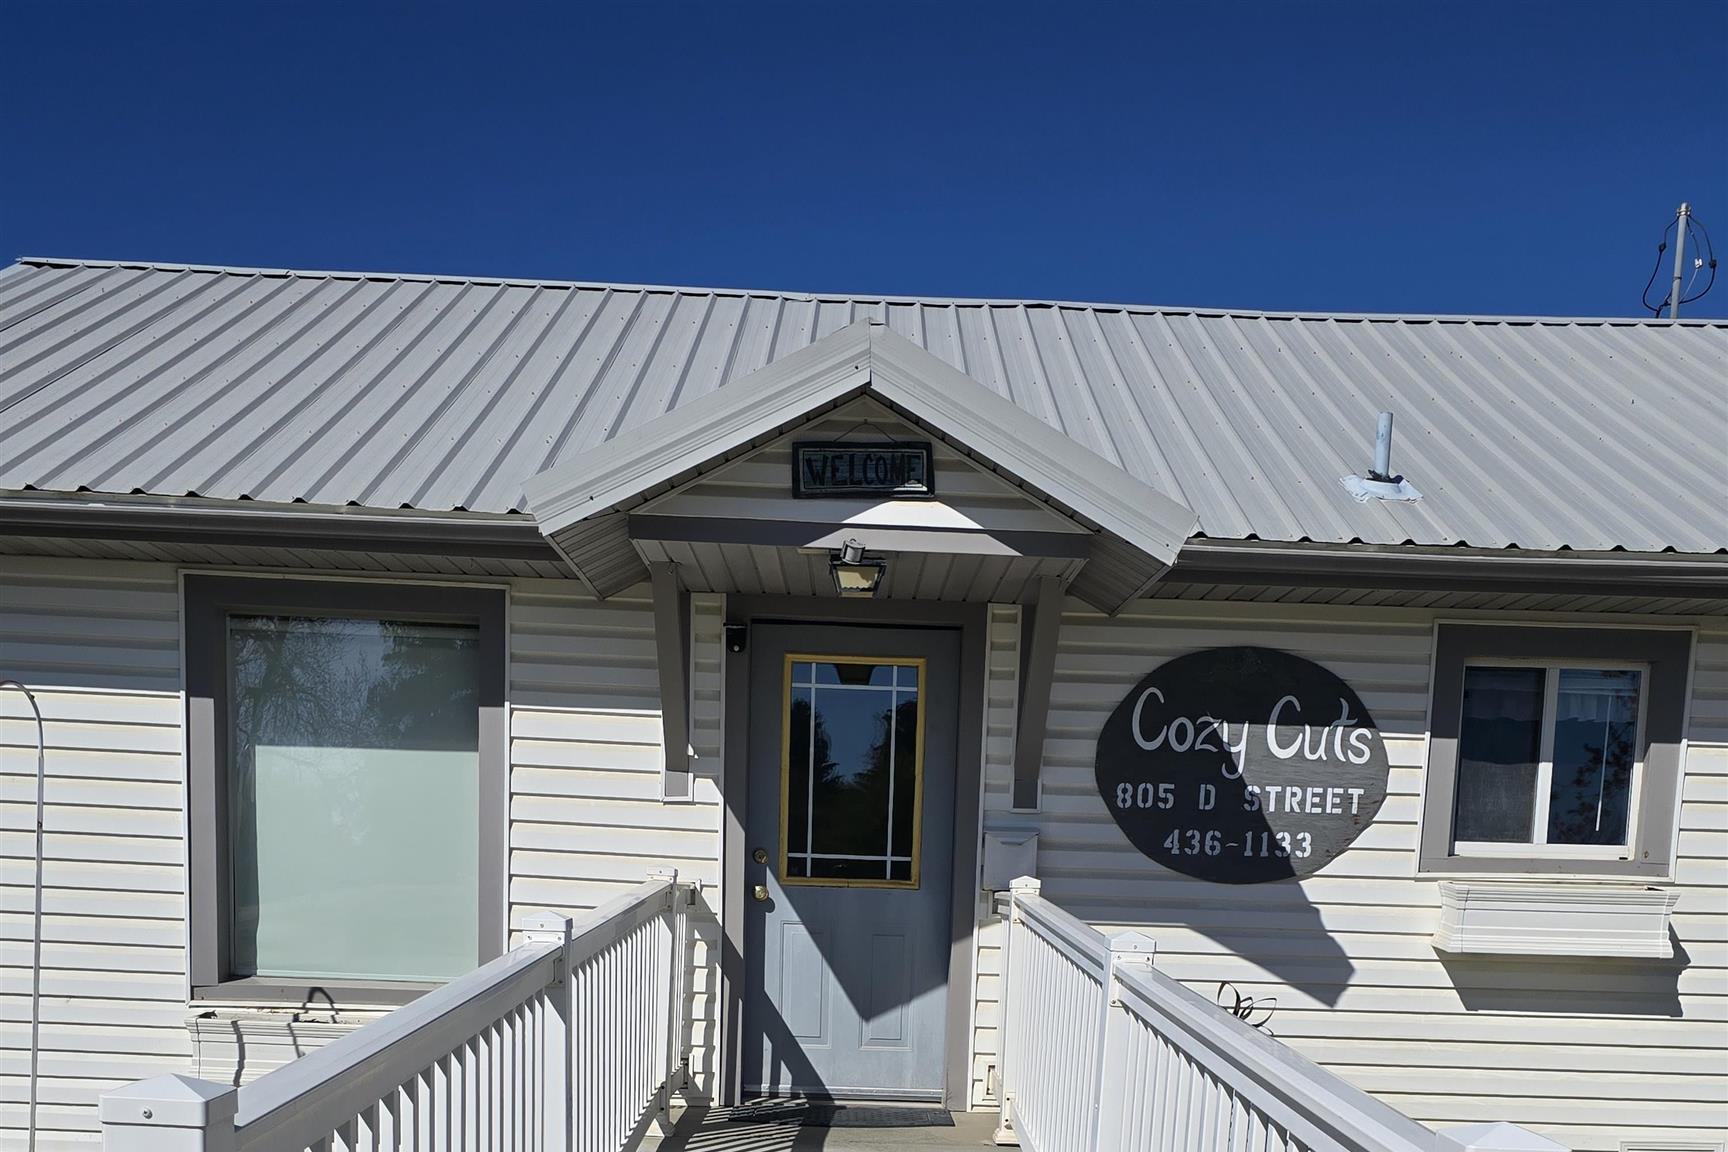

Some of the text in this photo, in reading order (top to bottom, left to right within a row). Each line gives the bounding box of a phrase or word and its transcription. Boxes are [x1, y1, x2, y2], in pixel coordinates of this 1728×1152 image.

[805, 453, 922, 486] WELCOME
[1131, 686, 1373, 780] Cozy Cuts
[1115, 782, 1365, 815] 805 D STREET
[1163, 828, 1313, 858] 436-1133
